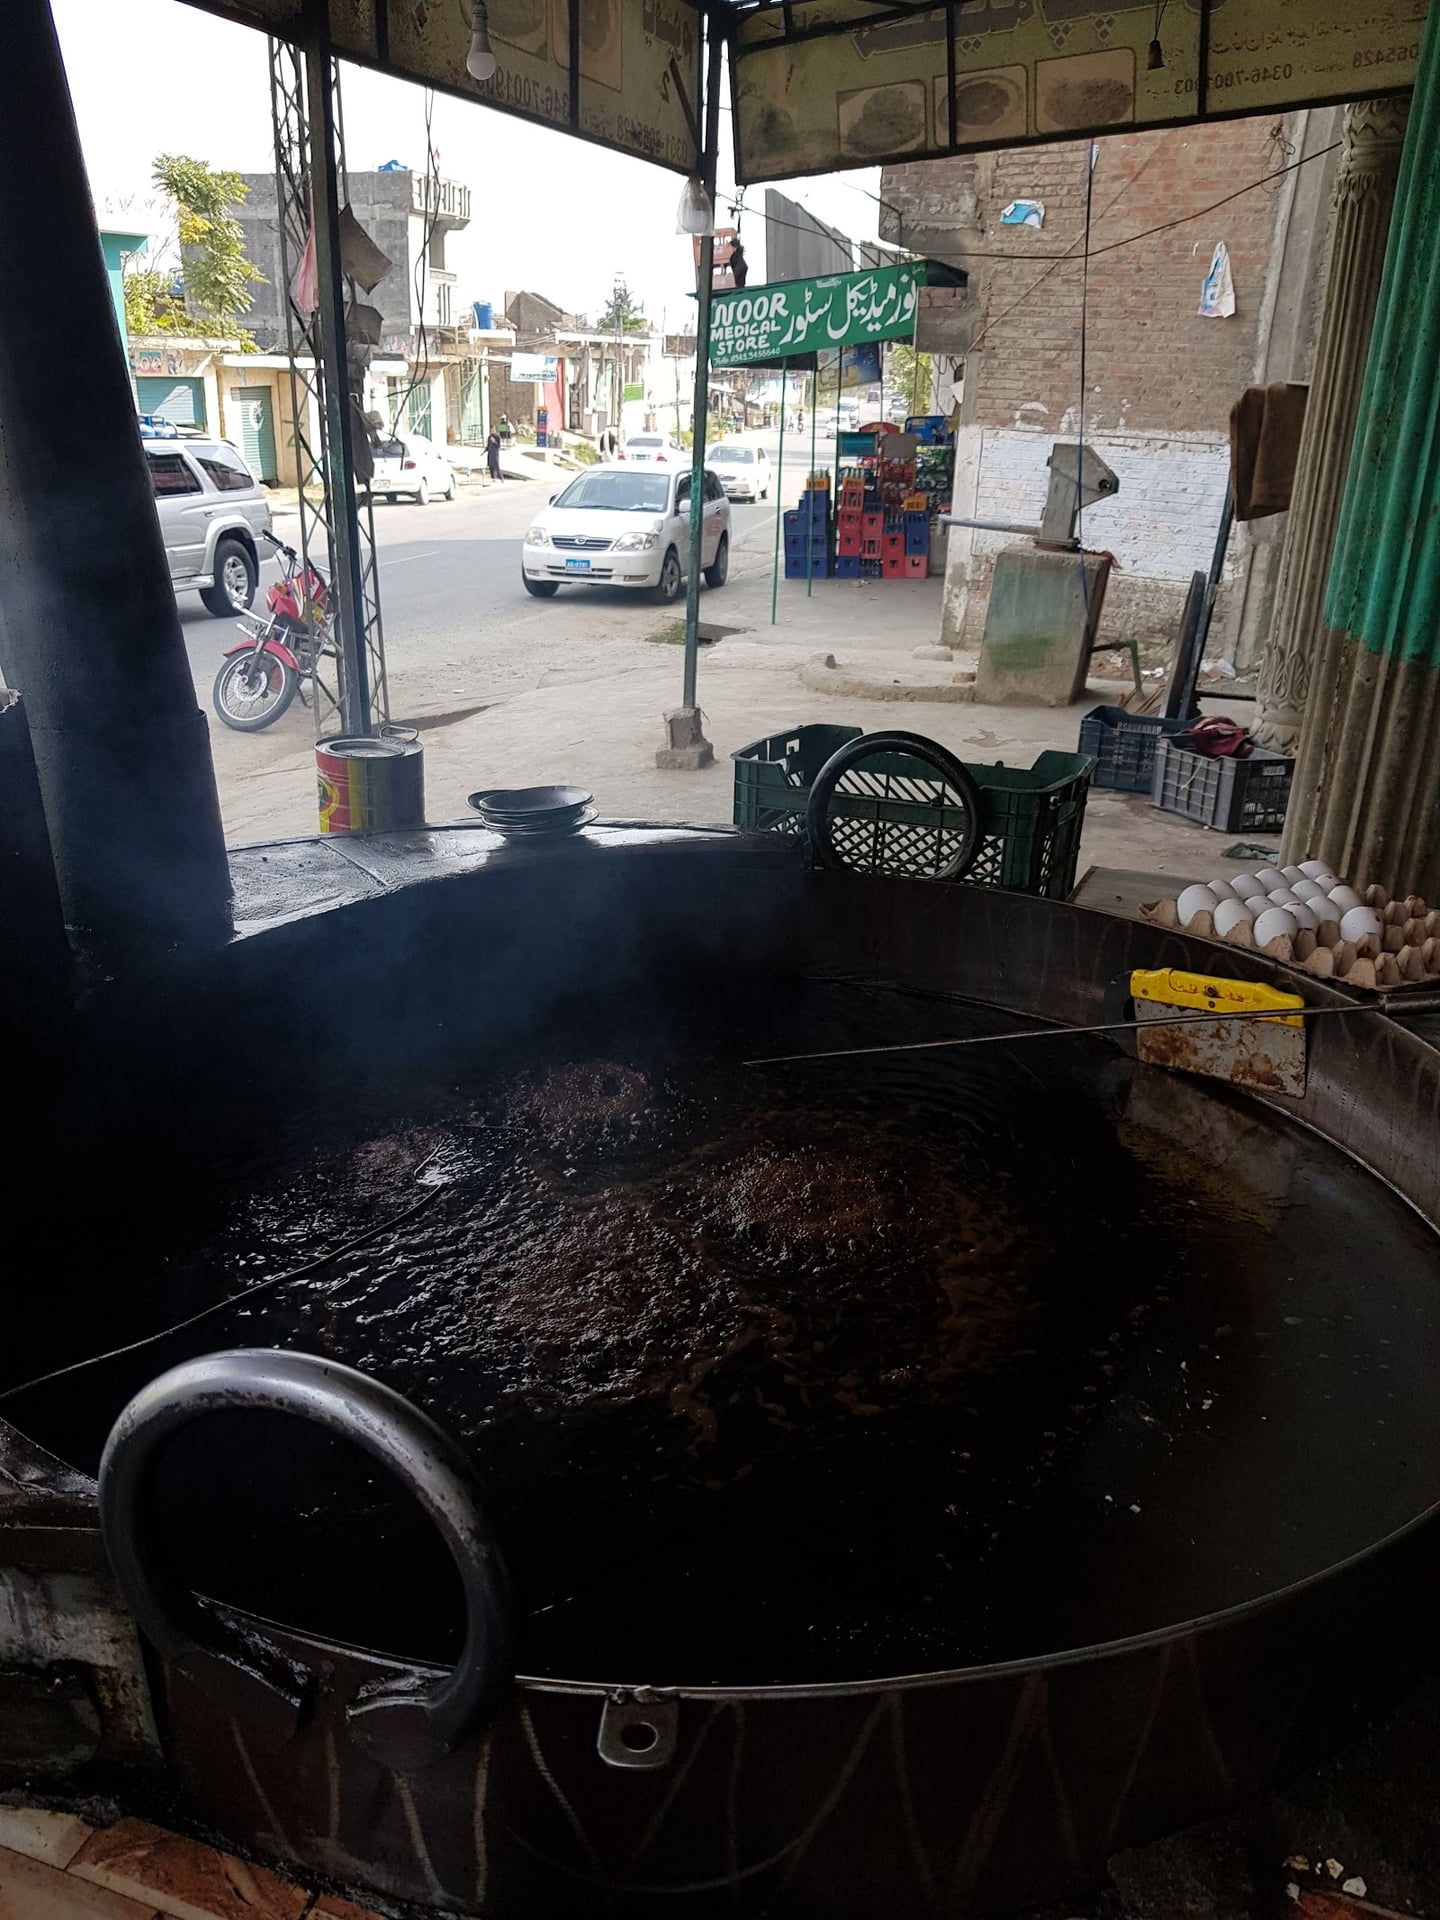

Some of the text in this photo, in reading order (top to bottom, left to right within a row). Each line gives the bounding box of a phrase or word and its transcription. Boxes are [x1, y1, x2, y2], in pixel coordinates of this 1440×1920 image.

[710, 292, 790, 328] NOOR
[710, 319, 782, 342] MEDICAL
[716, 334, 770, 356] STORE
